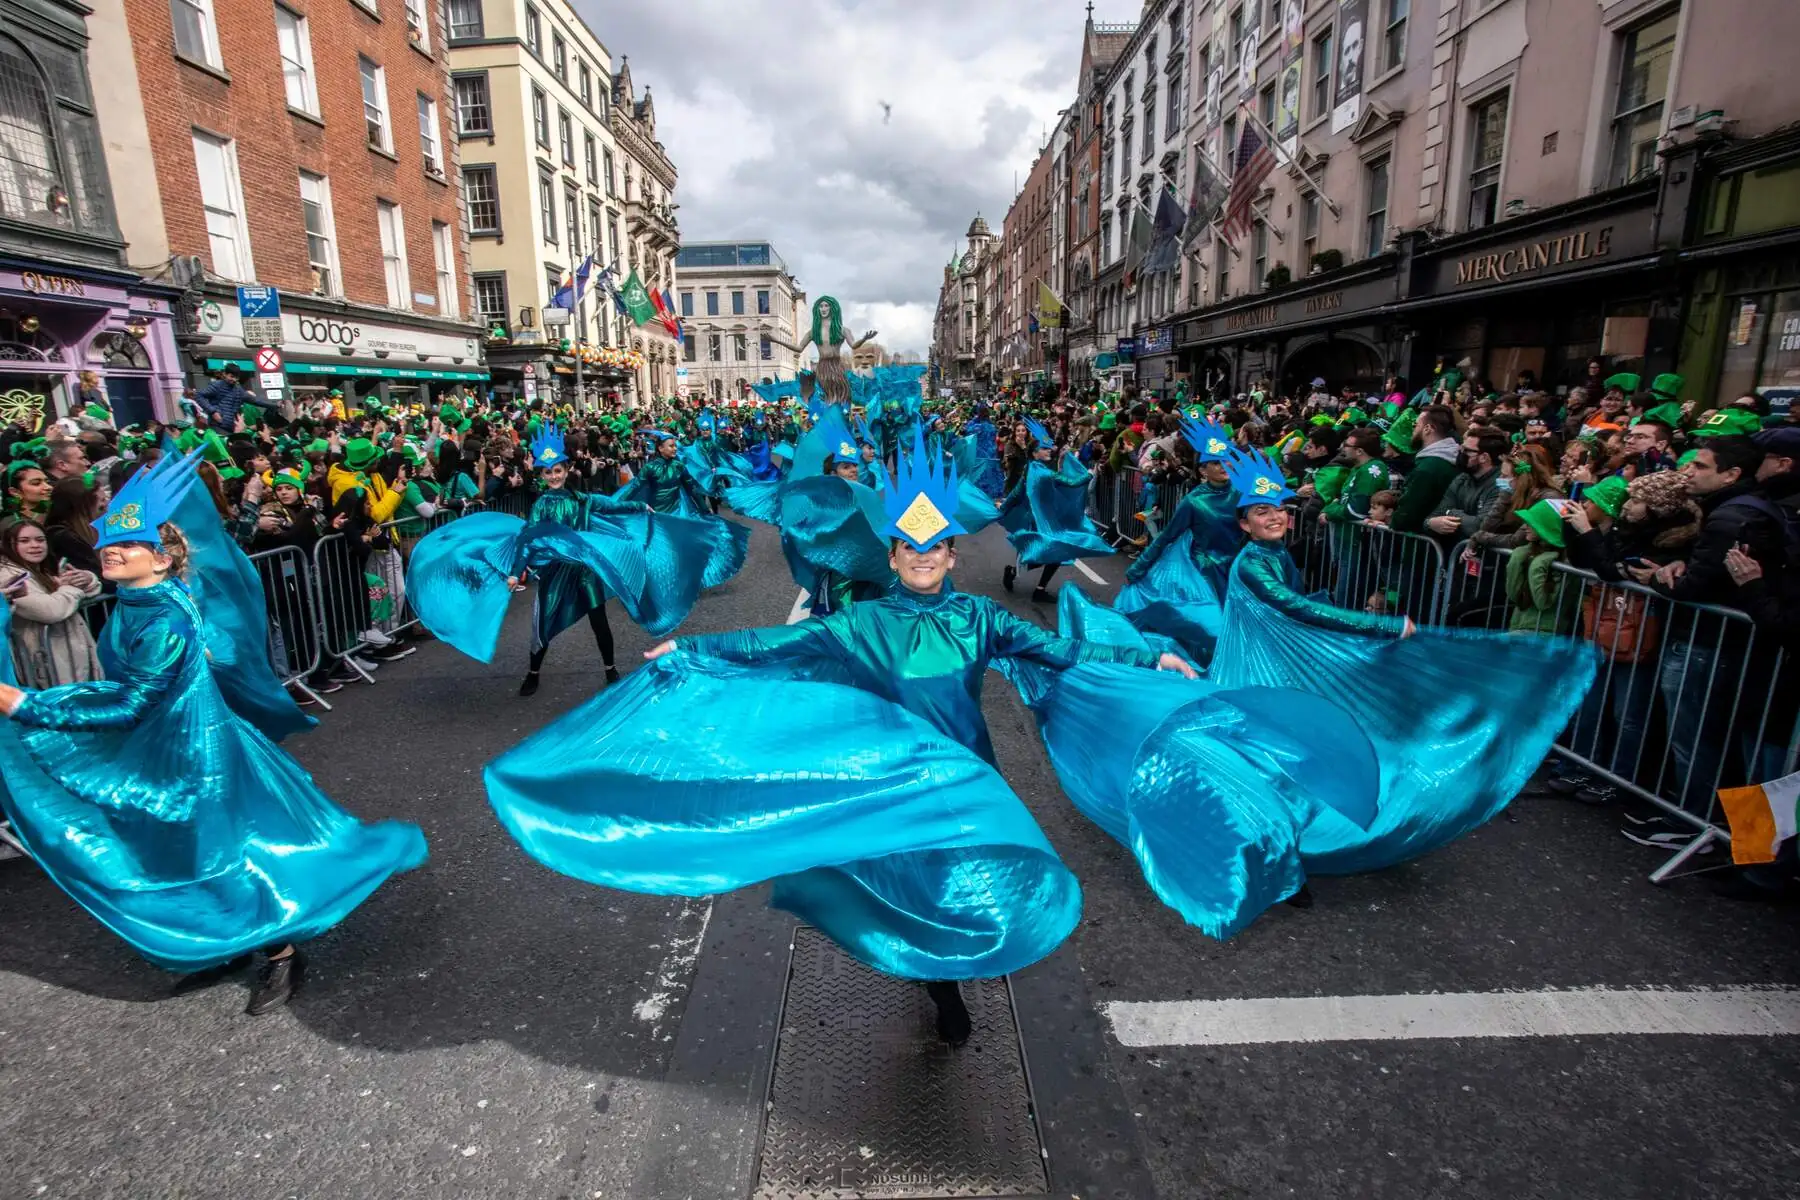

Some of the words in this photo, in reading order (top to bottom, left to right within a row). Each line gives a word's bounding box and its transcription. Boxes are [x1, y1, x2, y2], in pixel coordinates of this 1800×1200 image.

[1455, 226, 1613, 285] MERCANTILE
[22, 271, 85, 297] QUEEN
[1226, 306, 1278, 330] MERCANTILE
[1304, 291, 1344, 313] TAVERN
[871, 1172, 931, 1185] HUDSON
